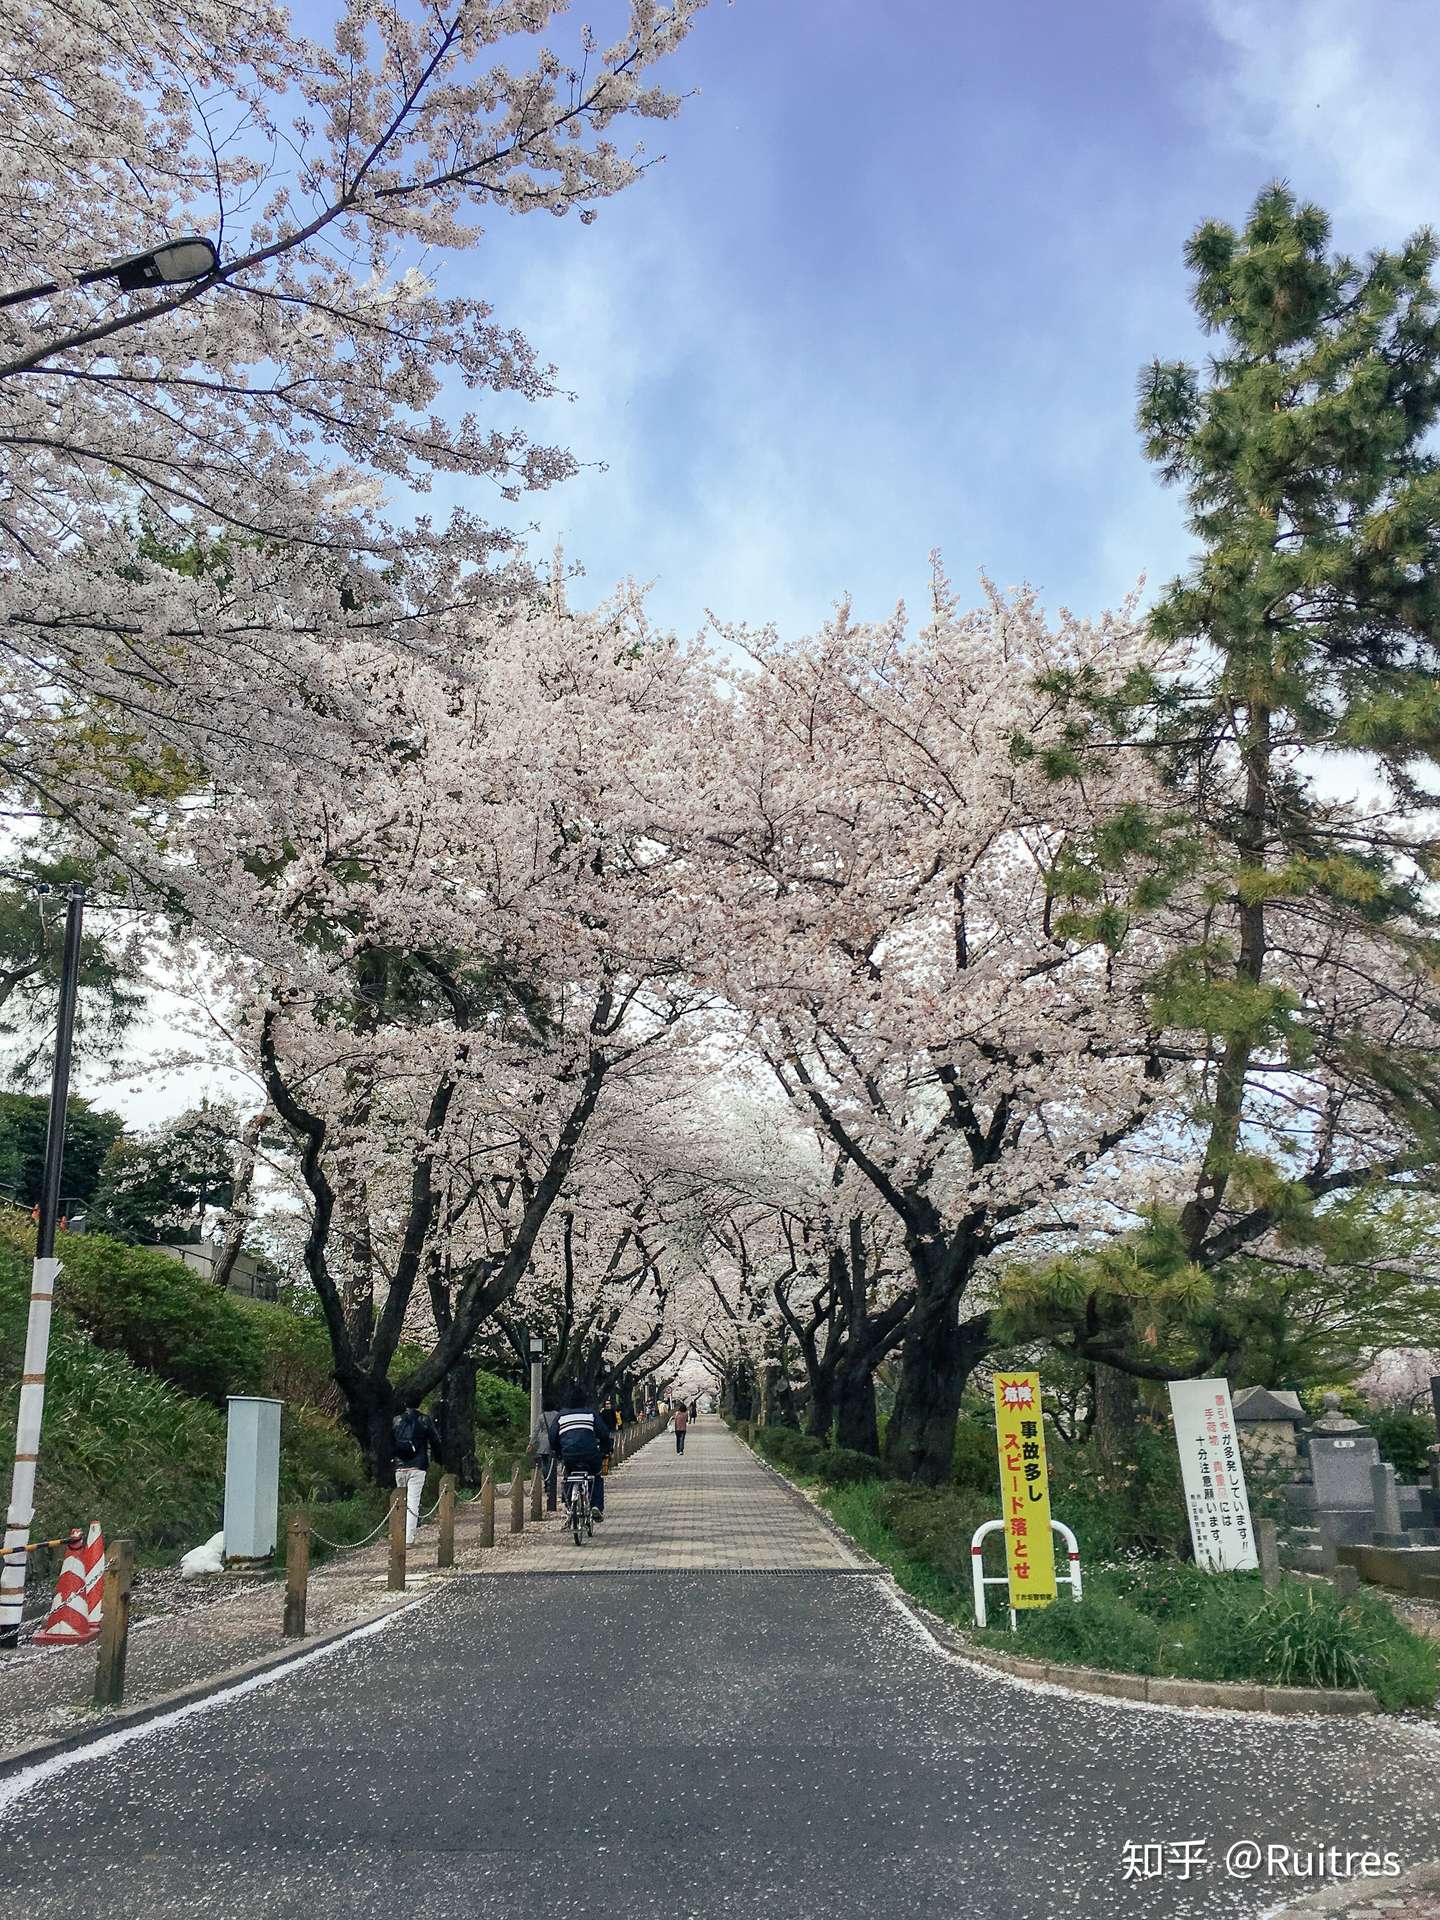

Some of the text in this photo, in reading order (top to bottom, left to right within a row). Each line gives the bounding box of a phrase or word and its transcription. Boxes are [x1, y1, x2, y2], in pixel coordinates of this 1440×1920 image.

[1004, 1433, 1031, 1580] スピード落とせ
[1020, 1421, 1043, 1502] 事故多し
